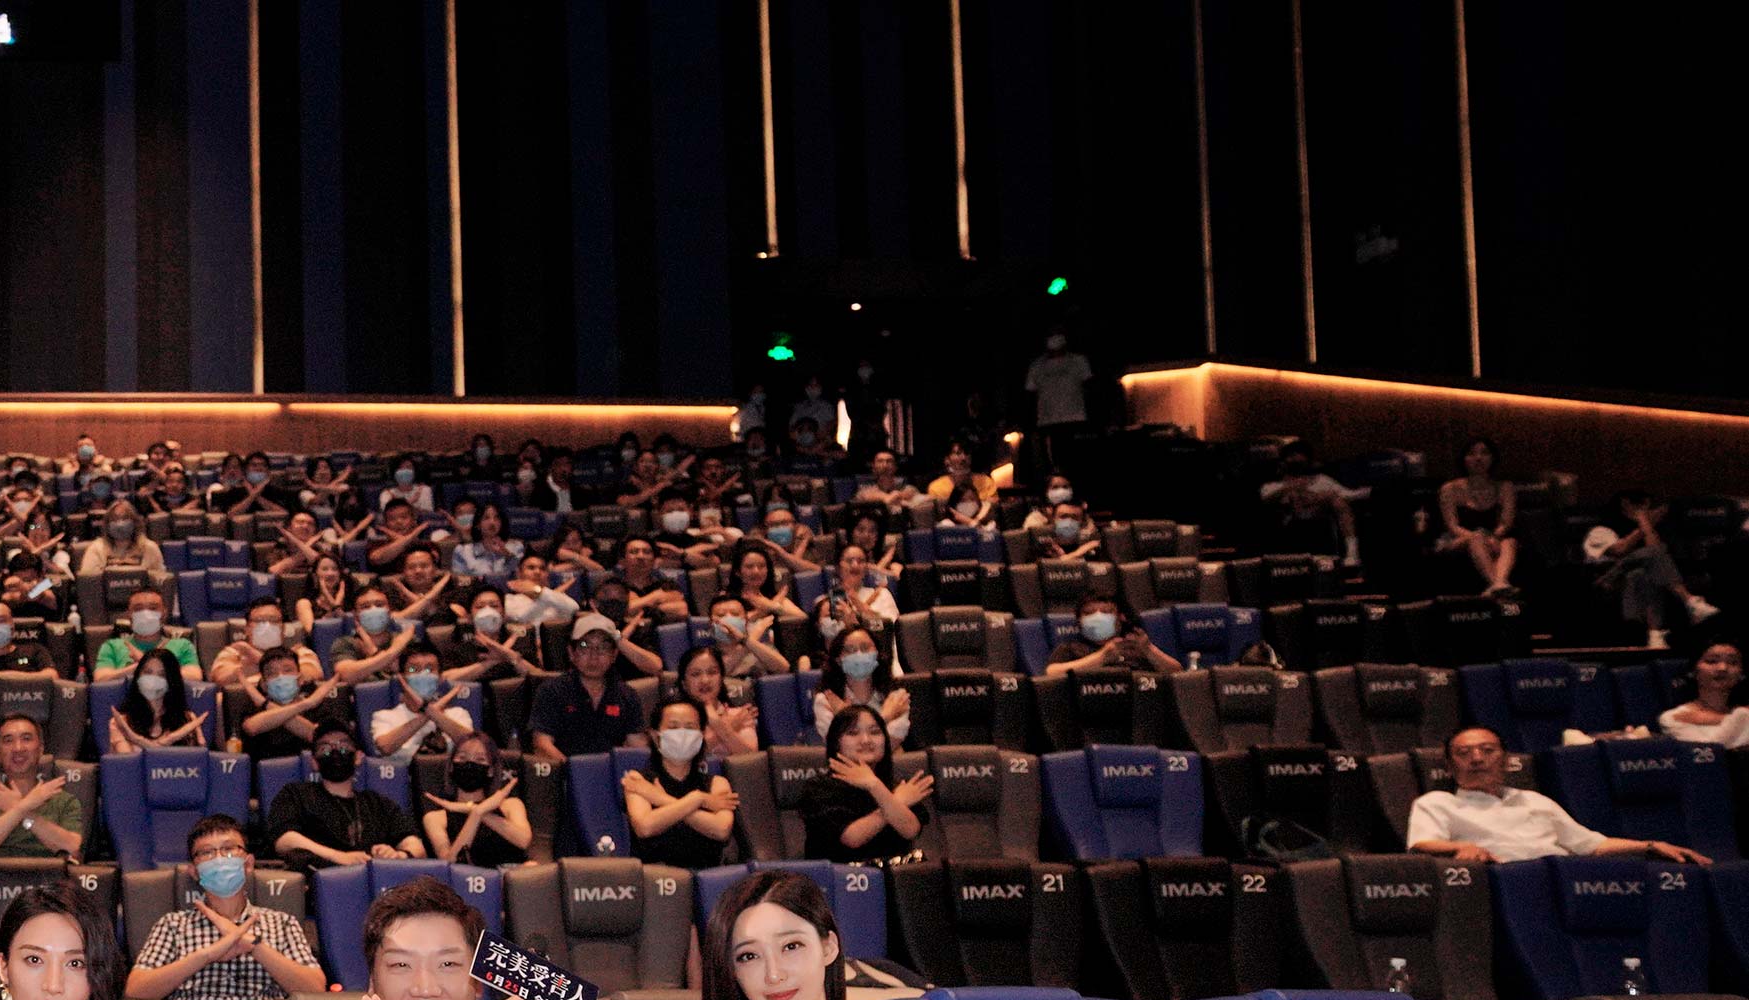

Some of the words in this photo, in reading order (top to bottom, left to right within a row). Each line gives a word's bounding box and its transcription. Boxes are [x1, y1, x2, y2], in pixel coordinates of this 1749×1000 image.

[2, 690, 45, 702] IMAX
[220, 759, 238, 774] 17
[378, 765, 395, 780] 18
[535, 762, 552, 777] 19
[942, 764, 996, 779] IMAX
[1009, 758, 1030, 773] 22
[1102, 764, 1154, 778] IMAX
[1267, 763, 1325, 777] IMAX
[1335, 756, 1357, 773] 24
[66, 769, 82, 783] 16
[150, 767, 200, 780] IMAX
[78, 873, 99, 892] 16
[465, 875, 486, 894] 18
[845, 873, 869, 892] 20
[1042, 873, 1065, 893] 21
[1242, 874, 1267, 893] 22
[1443, 867, 1471, 887] 23
[1660, 872, 1687, 891] 24
[266, 879, 287, 898] 17
[574, 885, 636, 902] IMAX
[655, 878, 677, 896] 19
[962, 884, 1026, 900] IMAX
[1161, 881, 1226, 898] IMAX
[1364, 882, 1433, 899] IMAX
[1573, 880, 1643, 897] IMAX
[484, 971, 530, 1000] 6月25日
